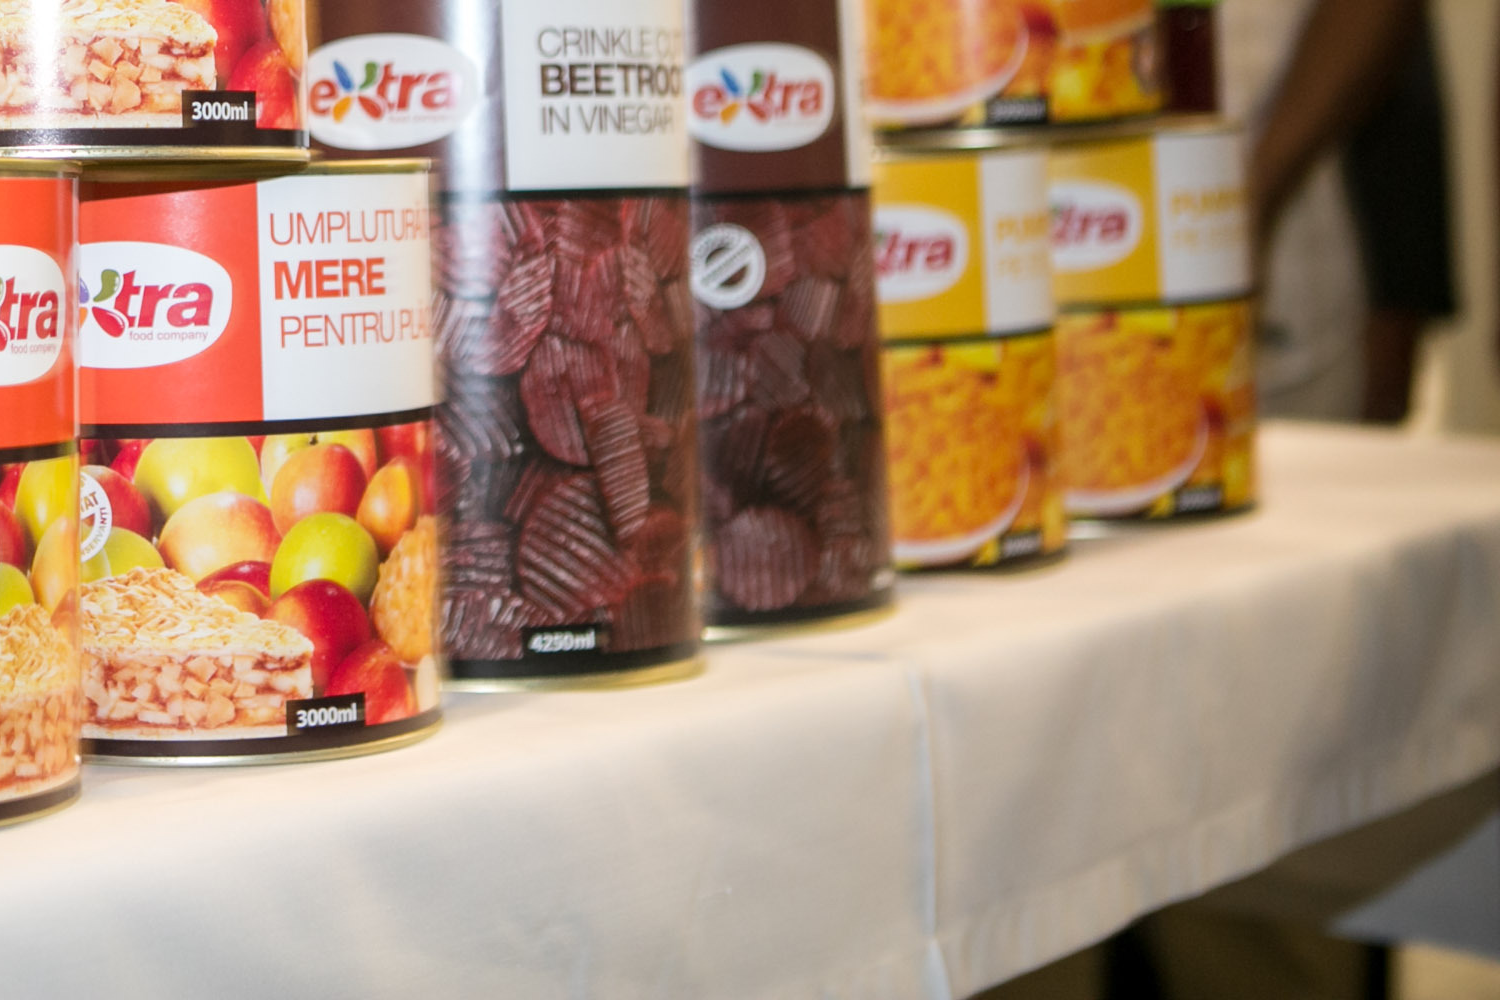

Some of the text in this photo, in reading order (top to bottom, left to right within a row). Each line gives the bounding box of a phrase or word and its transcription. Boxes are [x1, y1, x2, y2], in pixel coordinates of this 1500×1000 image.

[537, 27, 653, 59] CRINKLE
[540, 63, 681, 98] BEETROO
[191, 101, 248, 120] 3000ml
[542, 104, 674, 135] IN VINEGAR
[274, 257, 386, 300] MERE
[129, 330, 208, 343] food company
[281, 309, 396, 349] PENTRU
[296, 702, 358, 728] 3000ml
